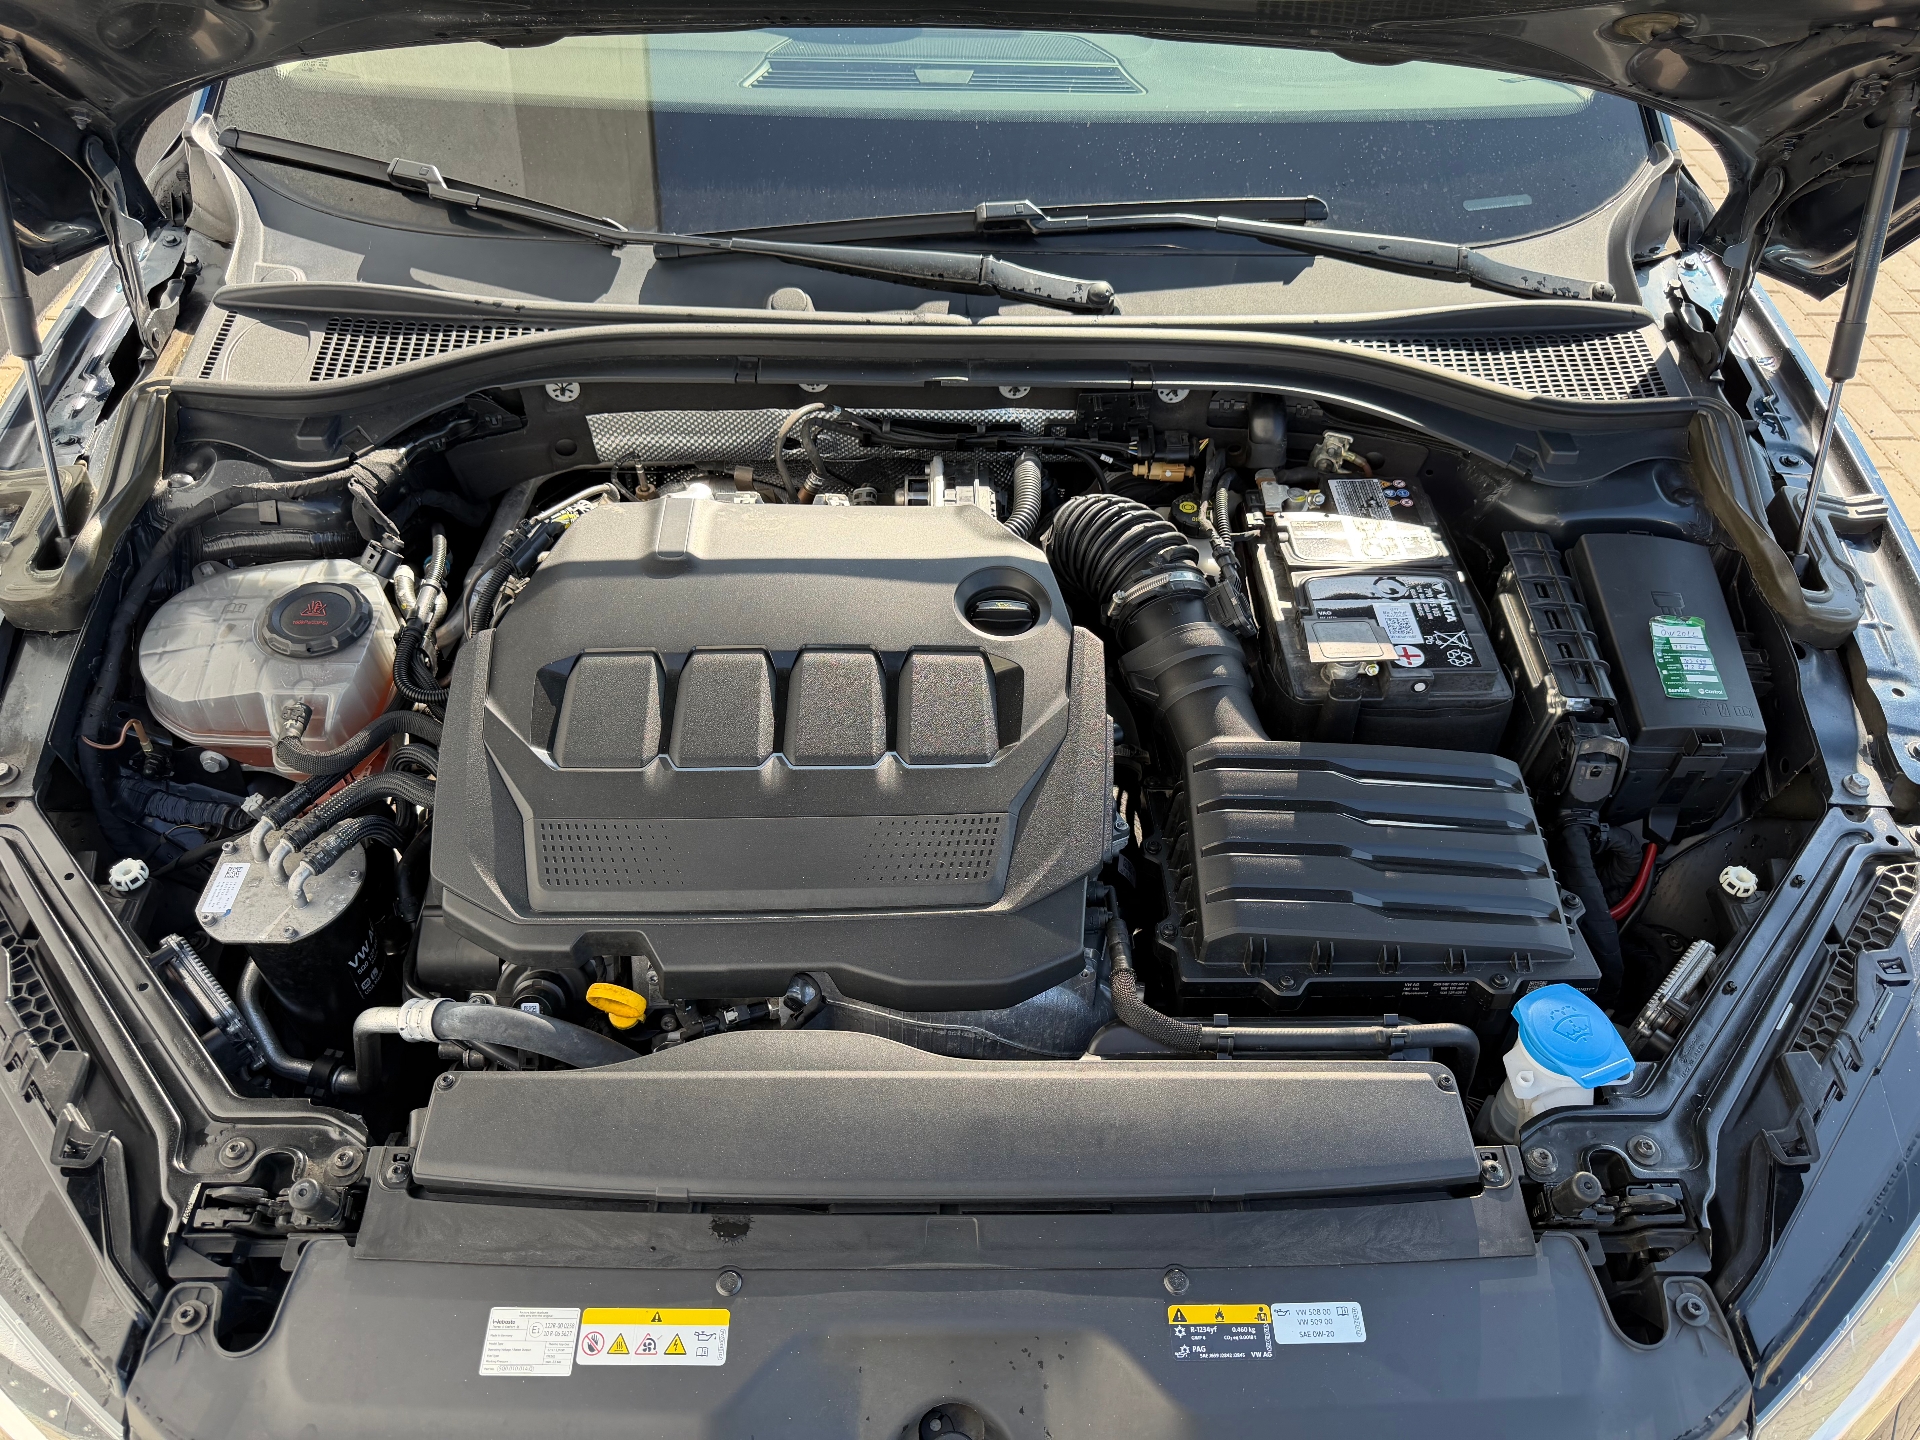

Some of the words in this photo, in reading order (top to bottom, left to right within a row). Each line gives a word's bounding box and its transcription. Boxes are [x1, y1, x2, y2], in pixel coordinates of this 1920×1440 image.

[1437, 592, 1456, 622] VARTA
[348, 940, 369, 968] VW
[1190, 1326, 1217, 1334] R-1234yf
